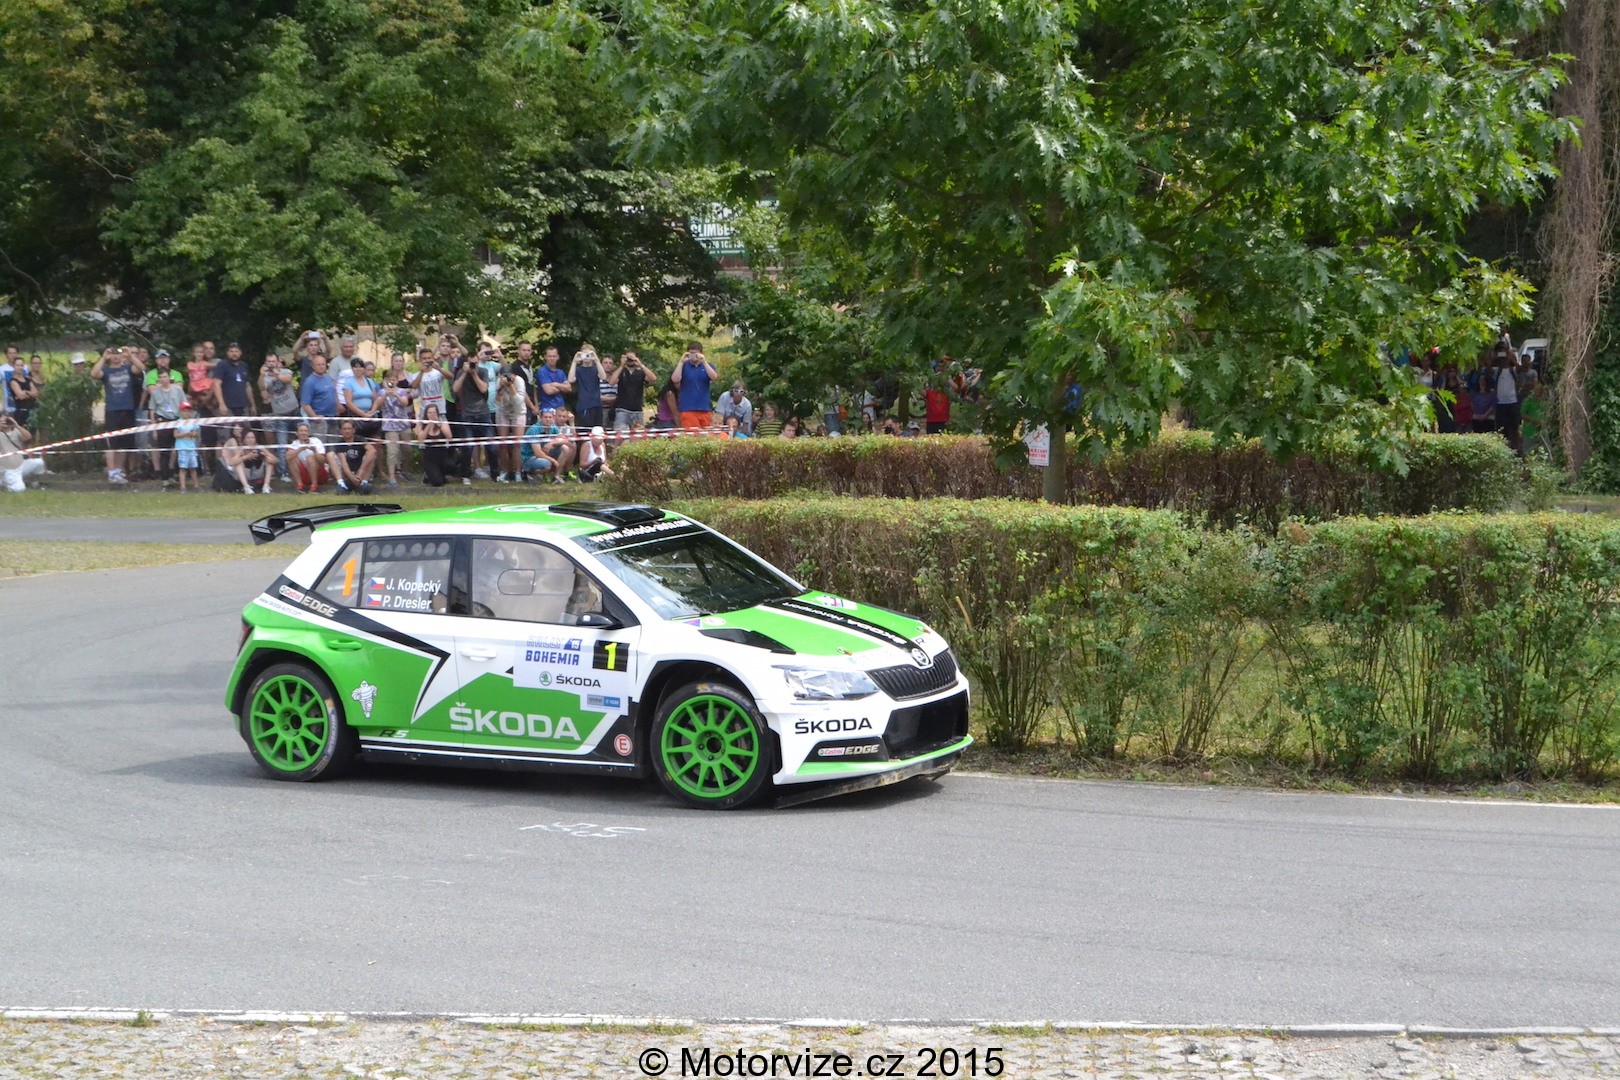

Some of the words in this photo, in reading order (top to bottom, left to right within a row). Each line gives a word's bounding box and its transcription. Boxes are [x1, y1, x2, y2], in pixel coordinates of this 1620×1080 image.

[341, 557, 358, 597] 1
[386, 578, 396, 590] J.
[397, 578, 442, 594] Kopecký
[301, 595, 339, 617] EDGE
[382, 597, 392, 608] P.
[393, 596, 432, 610] Dresler
[525, 649, 580, 666] BOHEMIA
[604, 641, 618, 670] 1
[556, 673, 601, 688] ŠKODA
[449, 701, 581, 741] ŠKODA
[794, 717, 873, 735] ŠKODA
[844, 743, 880, 755] EDGE
